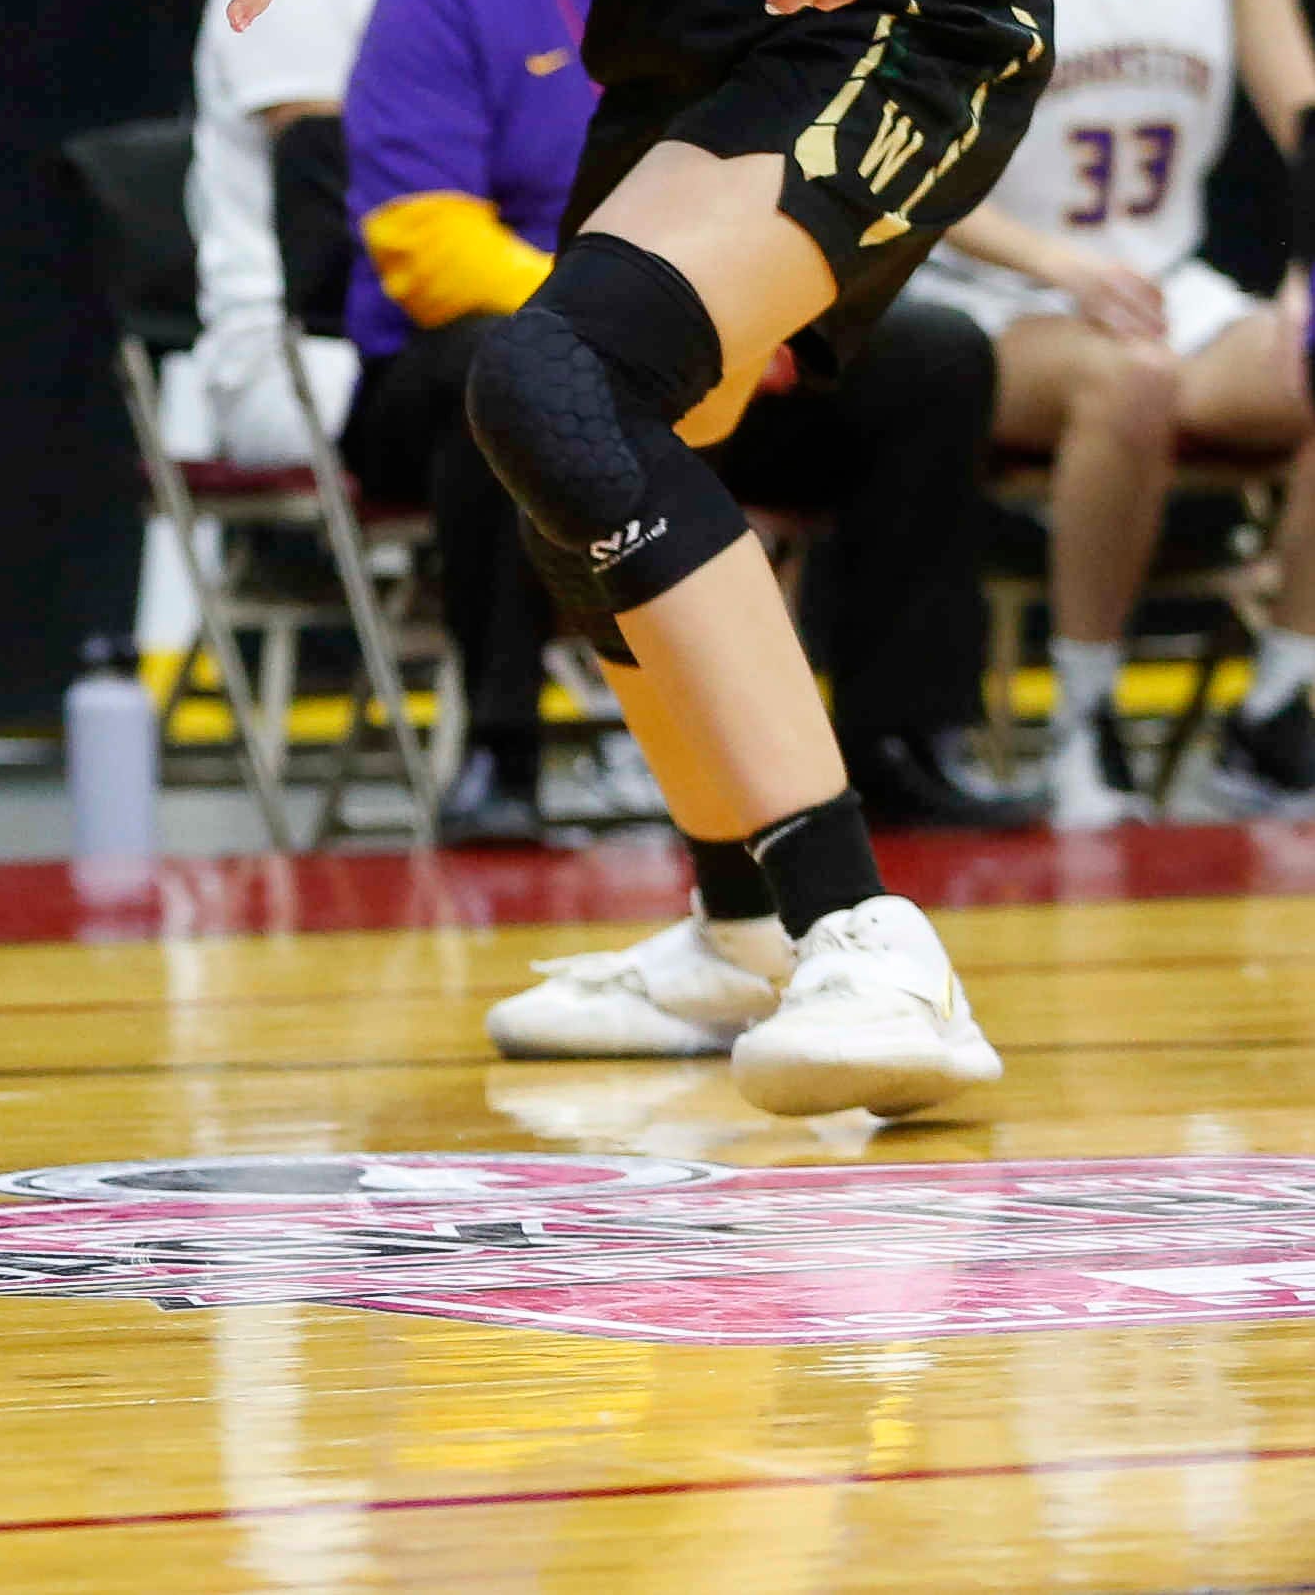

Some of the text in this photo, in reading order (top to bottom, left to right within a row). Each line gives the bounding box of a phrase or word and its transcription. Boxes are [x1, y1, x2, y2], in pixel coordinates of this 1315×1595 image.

[857, 98, 925, 195] W
[1063, 123, 1178, 227] 33
[798, 1299, 1181, 1327] IOWA
